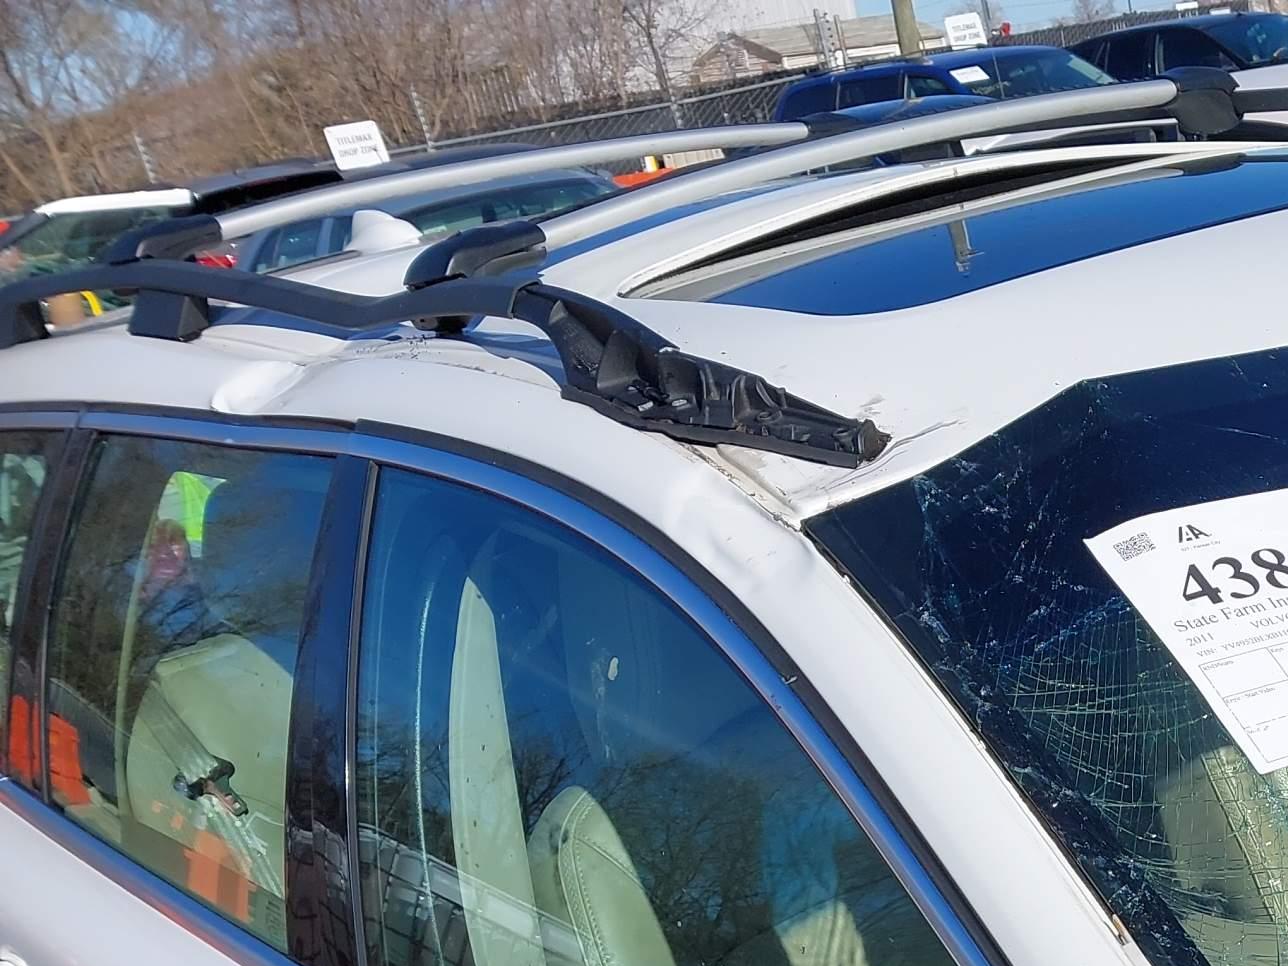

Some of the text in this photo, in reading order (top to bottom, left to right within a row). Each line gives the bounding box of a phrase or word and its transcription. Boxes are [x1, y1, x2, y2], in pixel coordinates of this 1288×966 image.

[1173, 613, 1219, 633] State
[1220, 602, 1267, 621] Farm
[1186, 632, 1215, 647] 2011
[1196, 646, 1217, 658] VIN:
